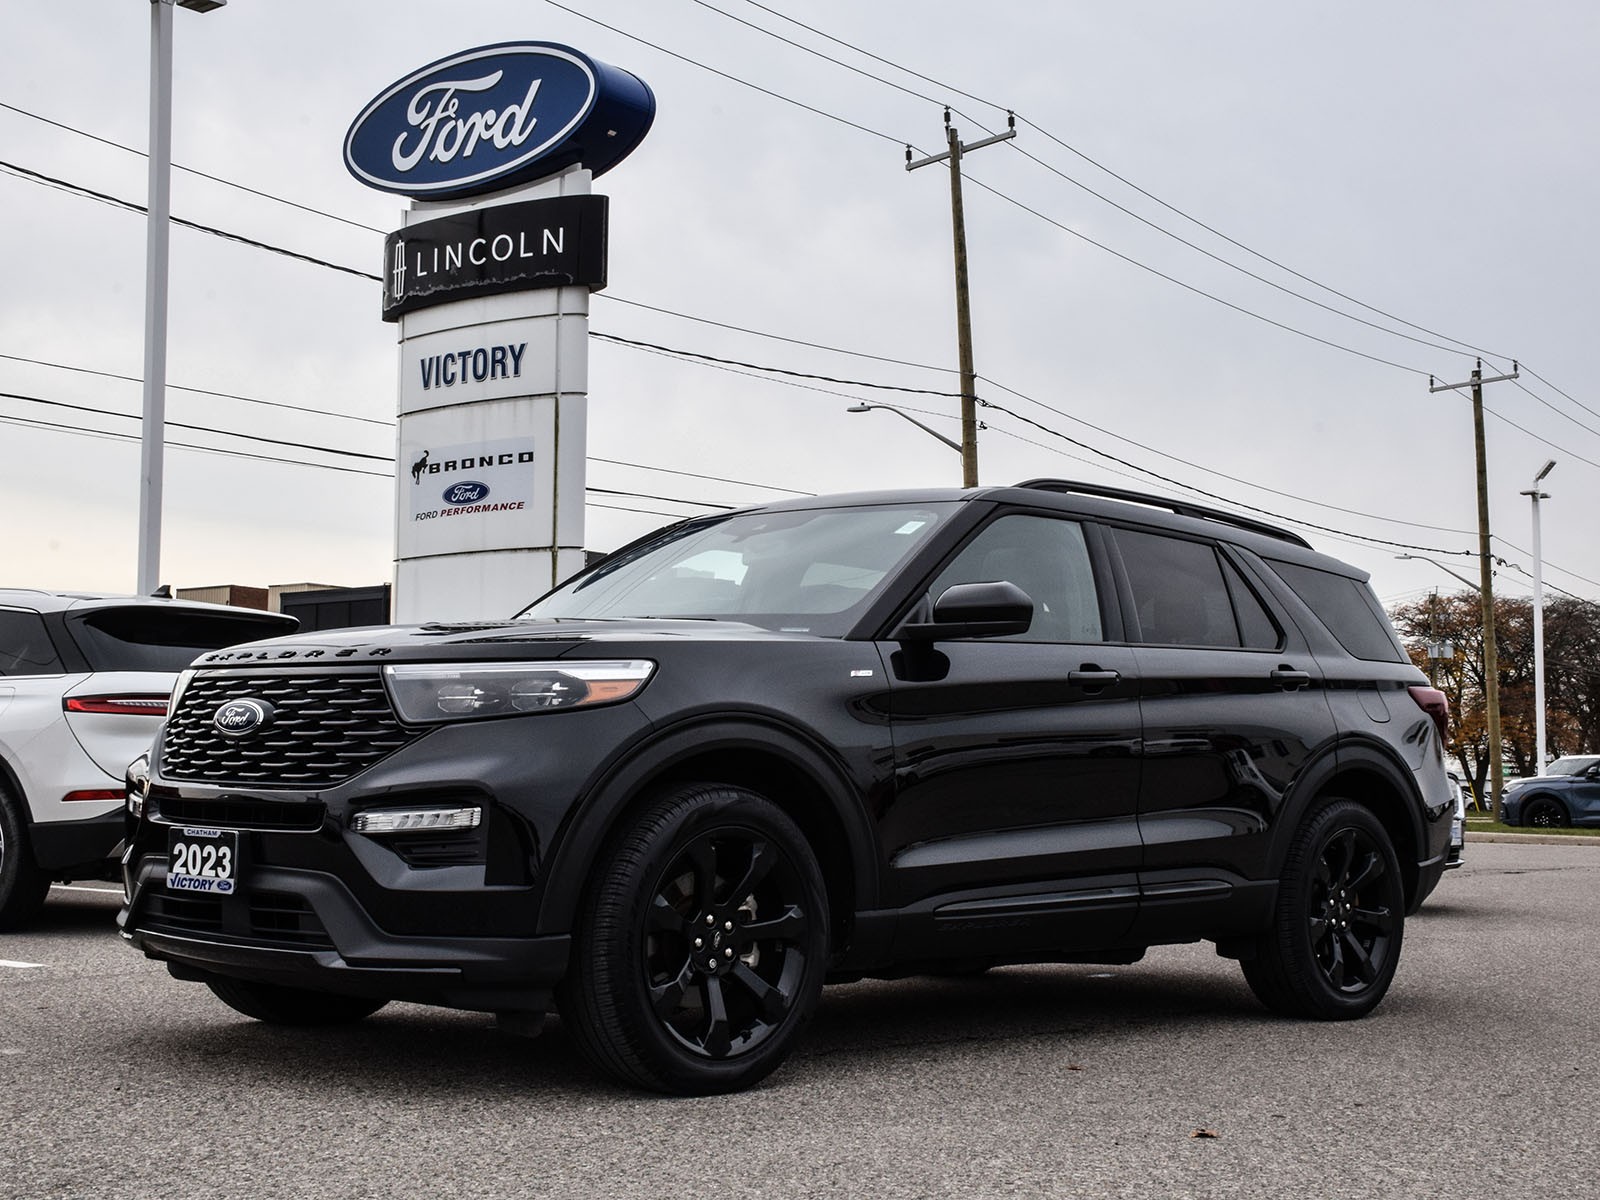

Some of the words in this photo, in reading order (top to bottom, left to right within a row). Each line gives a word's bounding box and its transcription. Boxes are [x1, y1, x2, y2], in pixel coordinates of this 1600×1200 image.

[392, 69, 542, 171] Ford
[417, 227, 564, 277] LINCOLN
[420, 342, 528, 390] VICTORY
[428, 451, 534, 475] BRONCO
[451, 484, 480, 502] Ford
[415, 510, 438, 521] FORD
[439, 501, 525, 518] PERFORMANCE
[205, 648, 392, 663] EXPLORER
[221, 706, 250, 726] Ford
[186, 828, 218, 836] CHATHAM
[172, 842, 232, 879] 2023
[170, 873, 215, 890] VICTORY
